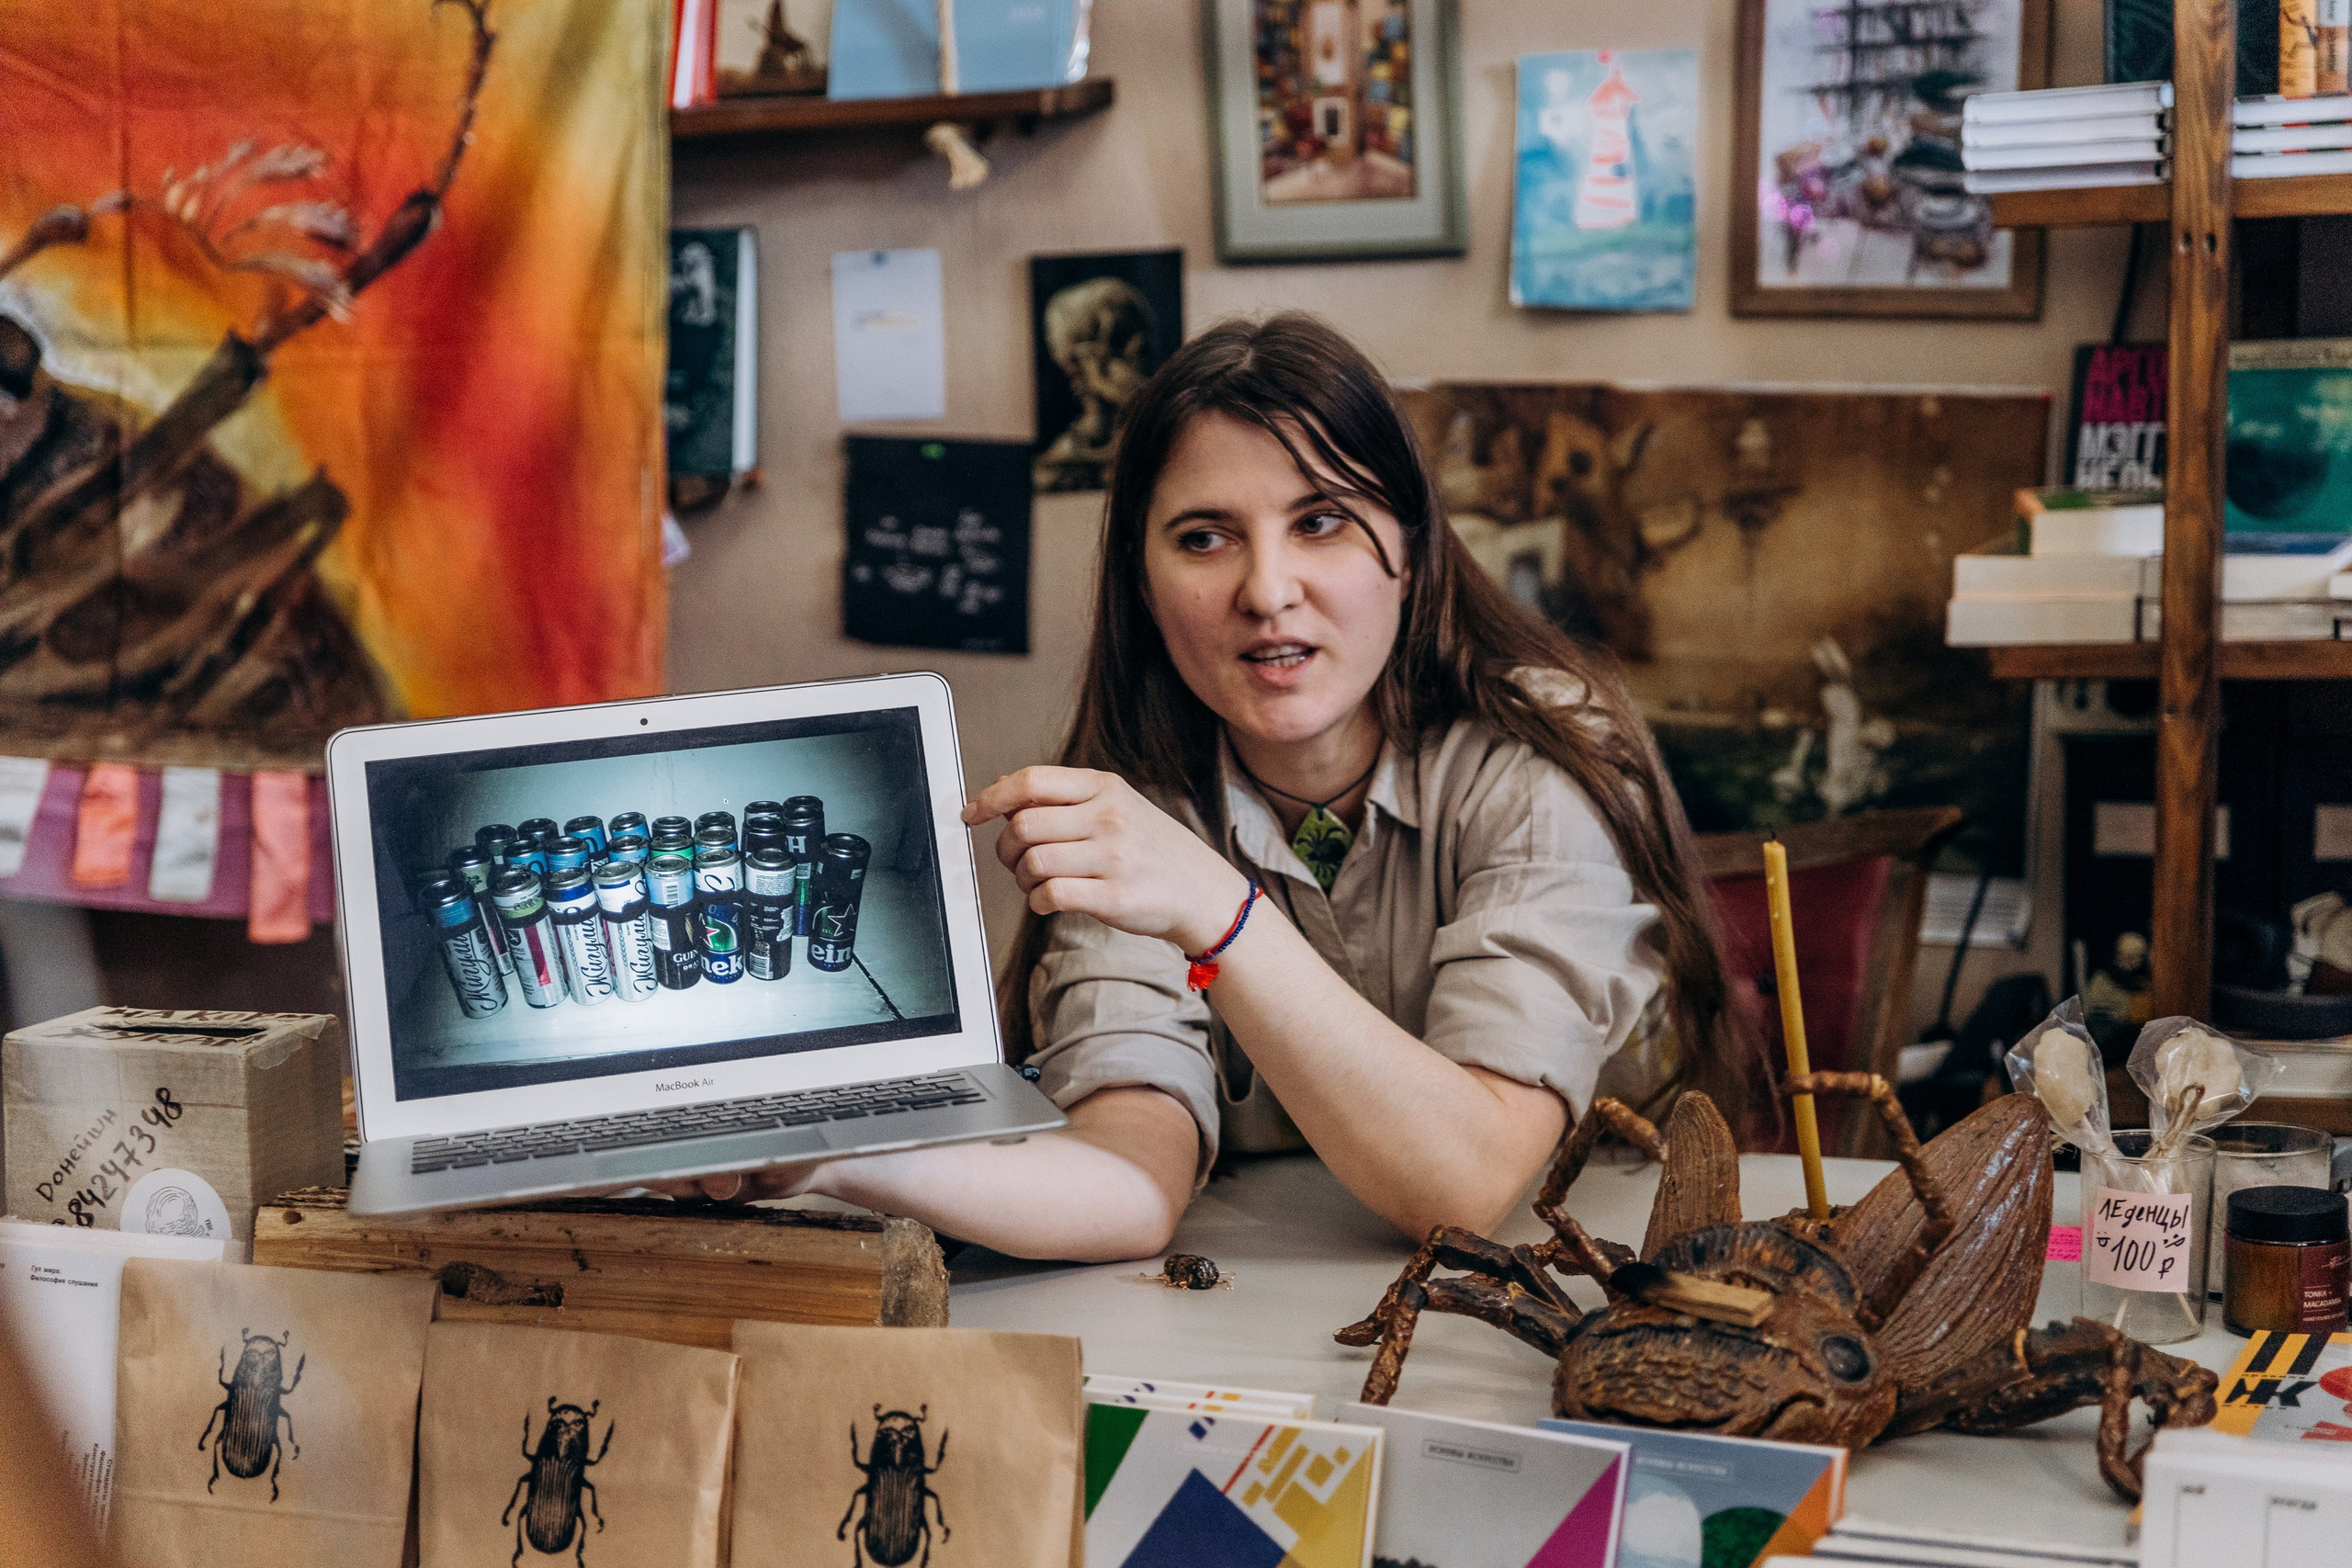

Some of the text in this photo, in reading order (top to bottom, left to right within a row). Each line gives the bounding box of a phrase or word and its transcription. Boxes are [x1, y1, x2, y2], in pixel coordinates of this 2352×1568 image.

[655, 1077, 715, 1092] MacBook Air
[36, 1108, 118, 1202] Донейшн
[51, 1087, 183, 1227] 84247348
[2111, 1235, 2156, 1272] 100
[30, 1274, 98, 1287] Философия слушания
[31, 1265, 41, 1273] Гул
